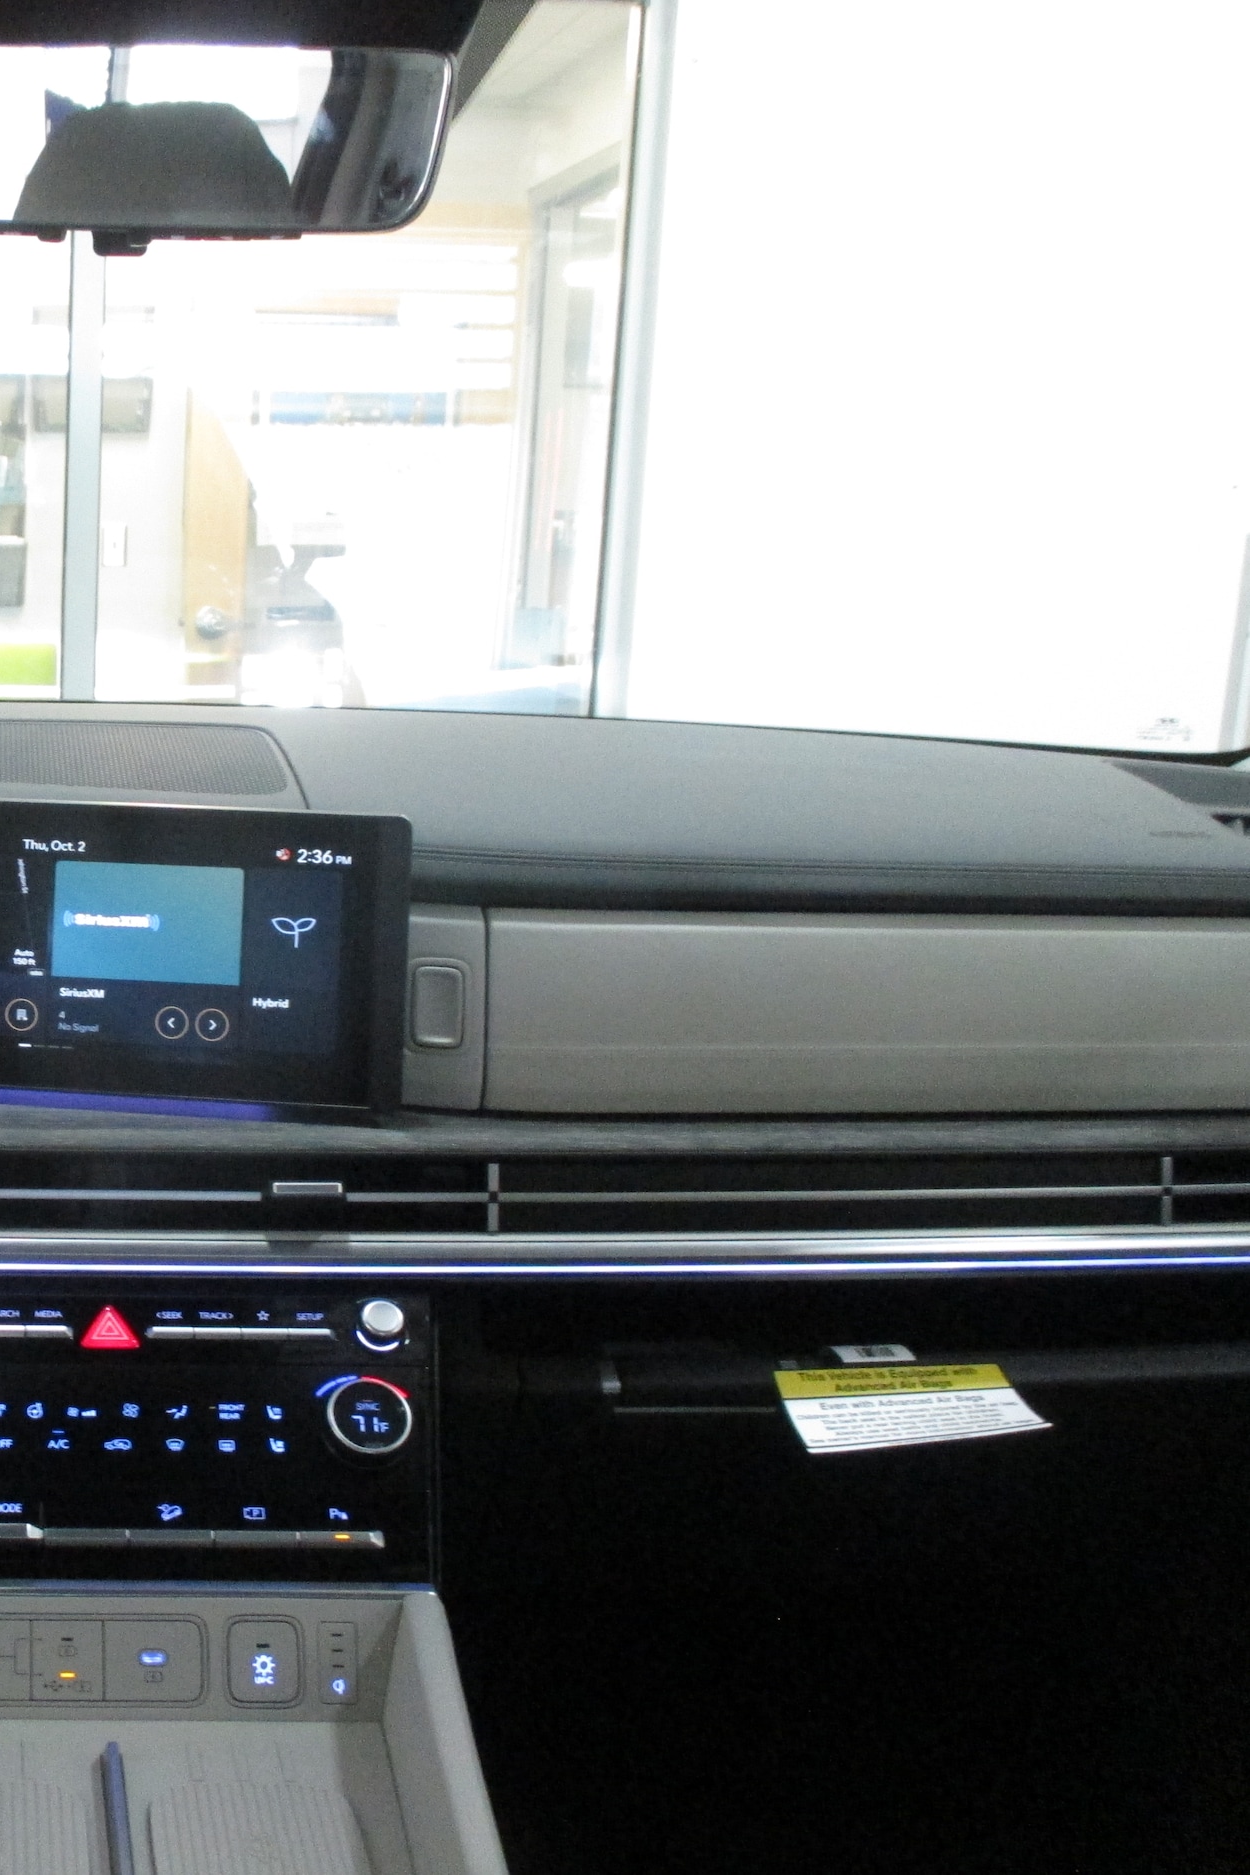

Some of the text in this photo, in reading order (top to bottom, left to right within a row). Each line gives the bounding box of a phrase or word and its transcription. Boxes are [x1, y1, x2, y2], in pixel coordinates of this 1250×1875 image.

[23, 839, 86, 853] Thu, Oct. 2
[297, 849, 352, 865] 2:36 PM
[14, 949, 35, 958] Auto
[13, 957, 27, 966] 150
[59, 987, 105, 999] SiriusXM
[252, 997, 290, 1009] Hybrid
[58, 1022, 100, 1034] No Signal
[34, 1310, 63, 1318] MEDIA
[296, 1312, 324, 1321] SETUP
[219, 1412, 241, 1420] REAR
[47, 1438, 70, 1450] A/C
